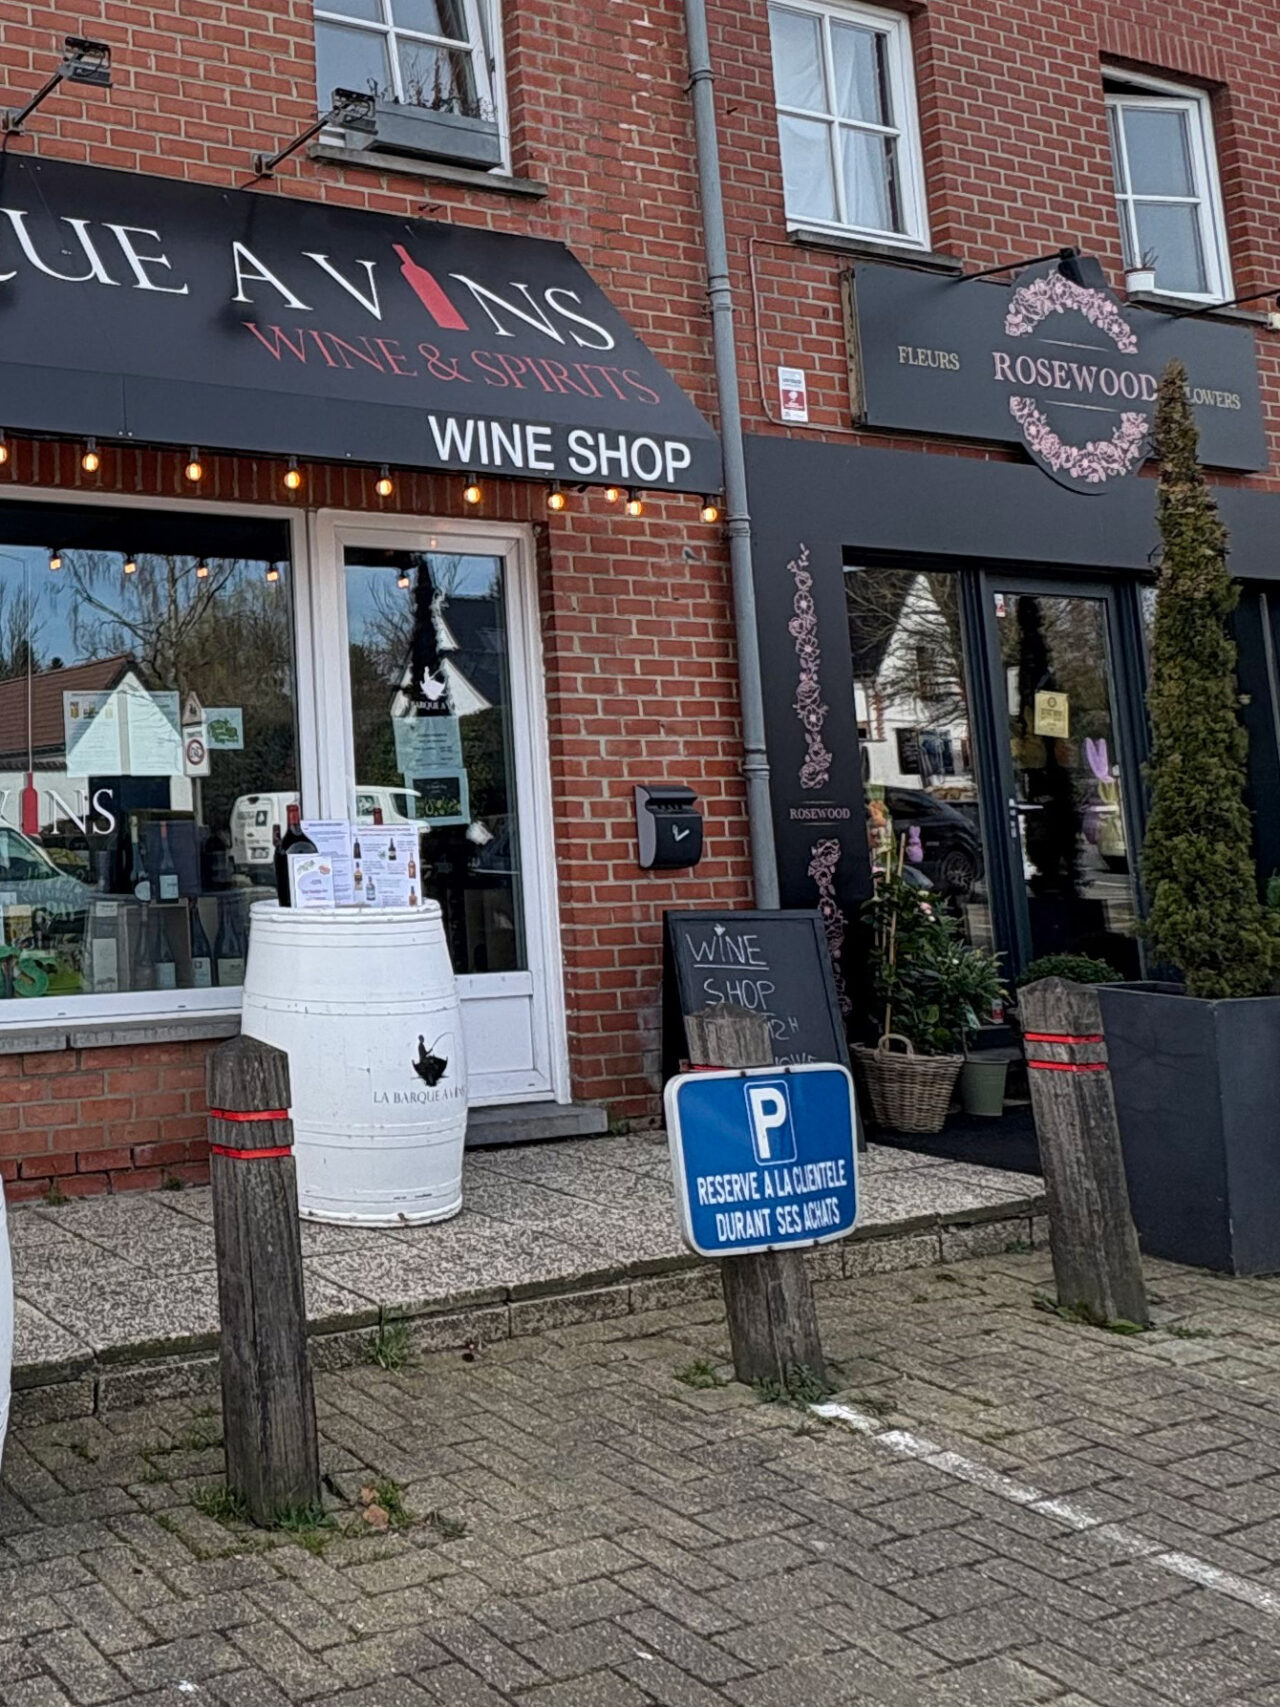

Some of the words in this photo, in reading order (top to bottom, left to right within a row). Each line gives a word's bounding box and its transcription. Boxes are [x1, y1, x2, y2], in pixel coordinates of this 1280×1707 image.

[232, 240, 314, 311] A
[302, 243, 615, 351] VINS
[242, 321, 418, 377] WINE
[419, 343, 463, 384] &
[476, 351, 661, 405] SPIRITS
[897, 346, 960, 371] FLEURS
[992, 352, 1159, 401] ROSEWOOD
[1182, 386, 1241, 410] LOWERS
[428, 416, 554, 471] WINE
[569, 429, 692, 483] SHOP
[789, 807, 851, 820] ROSEWOOD
[685, 930, 767, 966] WINE
[703, 978, 775, 1010] SHOP
[374, 1091, 389, 1103] LA
[393, 1090, 439, 1104] BARQUE
[749, 1088, 787, 1159] P
[697, 1171, 760, 1206] RESERVE
[764, 1170, 774, 1198] A
[775, 1168, 793, 1197] LA
[793, 1159, 847, 1194] CLIENTELE
[715, 1208, 770, 1242] DURANT
[776, 1204, 802, 1235] SES
[803, 1197, 840, 1230] ACHATS
